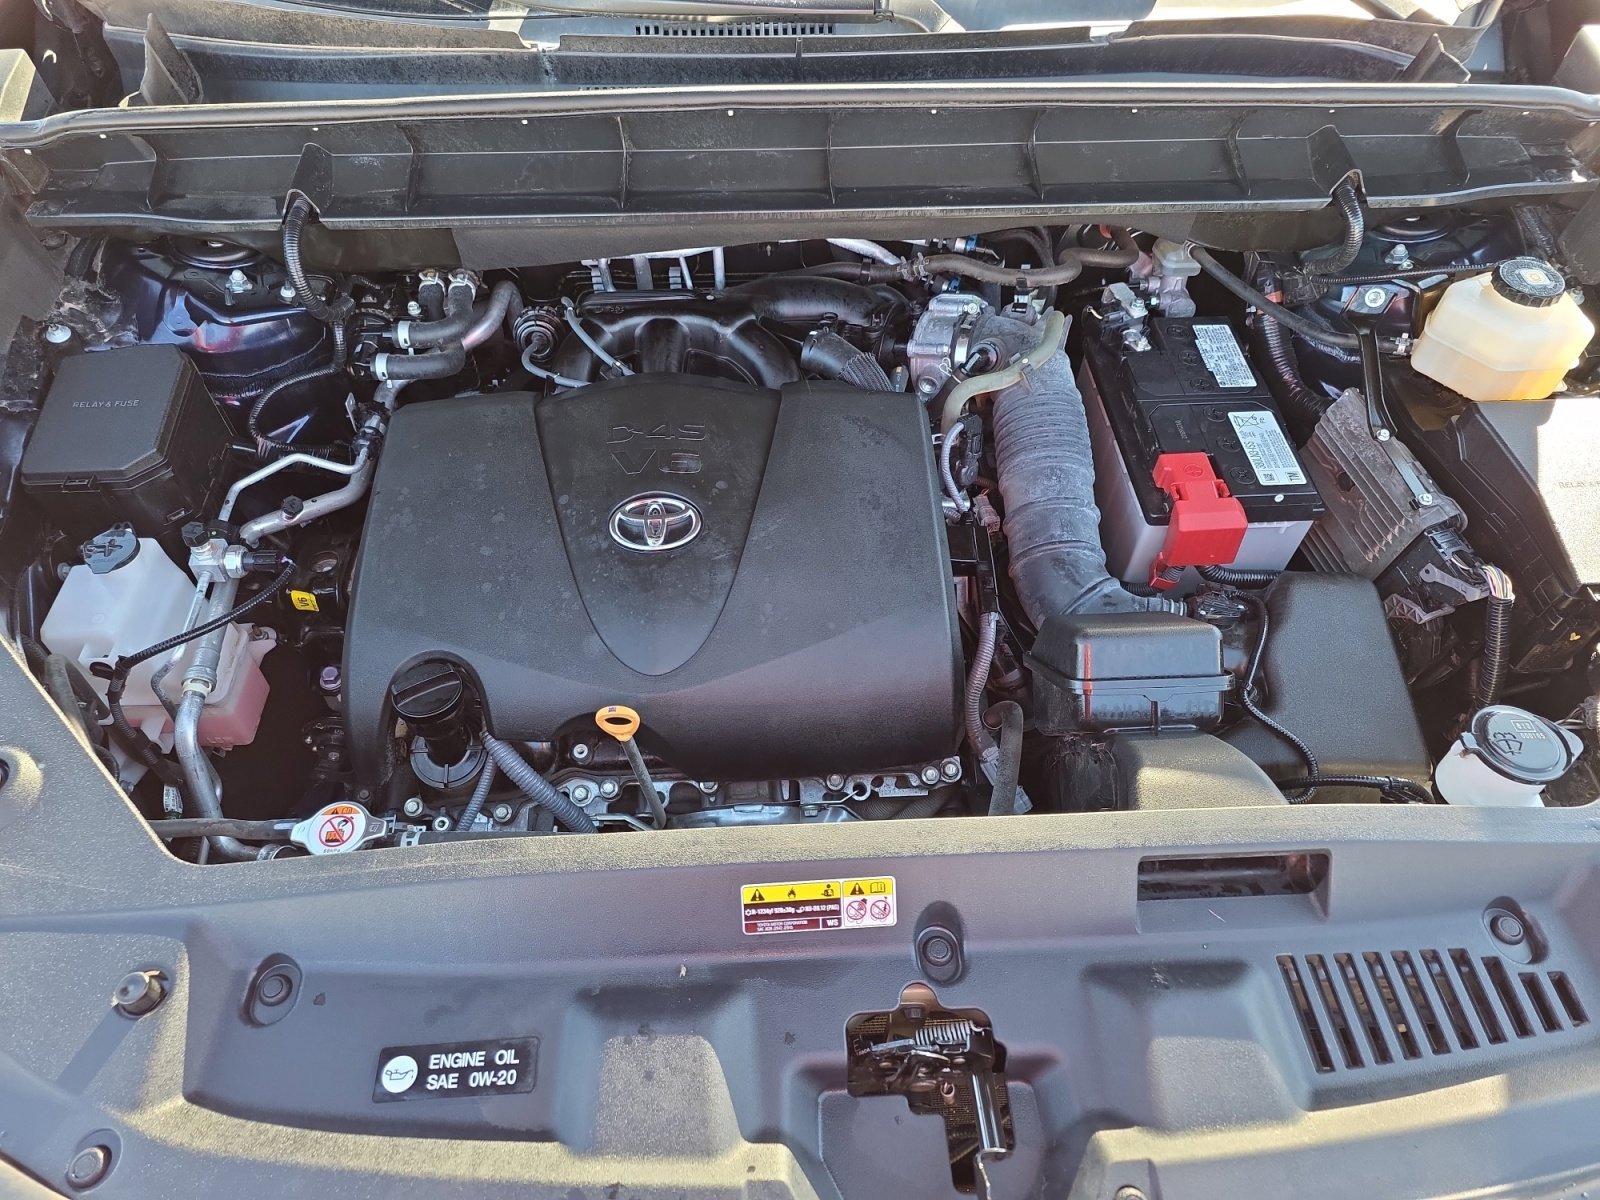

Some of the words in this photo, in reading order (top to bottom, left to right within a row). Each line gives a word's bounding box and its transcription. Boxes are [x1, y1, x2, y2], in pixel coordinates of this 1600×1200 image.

[114, 399, 140, 407] FUSE
[609, 448, 702, 475] V6
[429, 1051, 486, 1069] ENGINE
[495, 1049, 520, 1065] OIL
[426, 1073, 459, 1090] SAE
[469, 1069, 517, 1088] 0W-20
